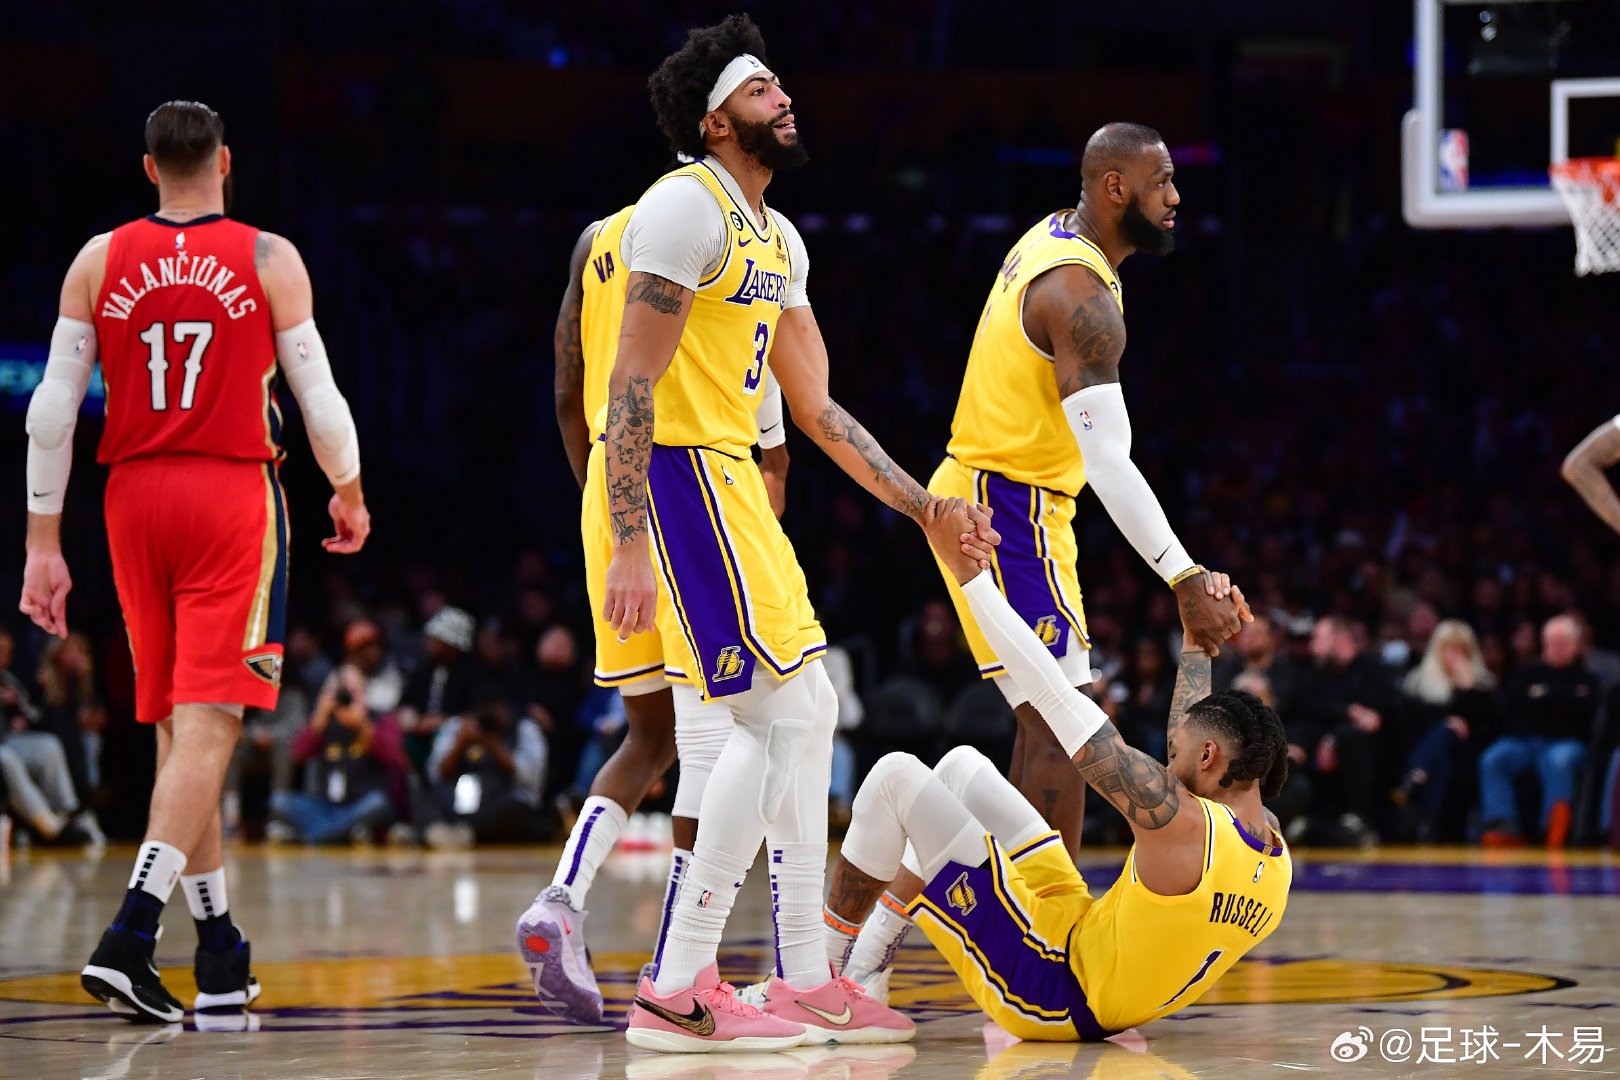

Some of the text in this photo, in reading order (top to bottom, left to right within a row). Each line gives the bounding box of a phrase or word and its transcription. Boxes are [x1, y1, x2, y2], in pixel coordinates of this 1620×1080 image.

[139, 321, 214, 411] 17
[743, 320, 770, 395] 3
[1156, 949, 1224, 1011] 1
